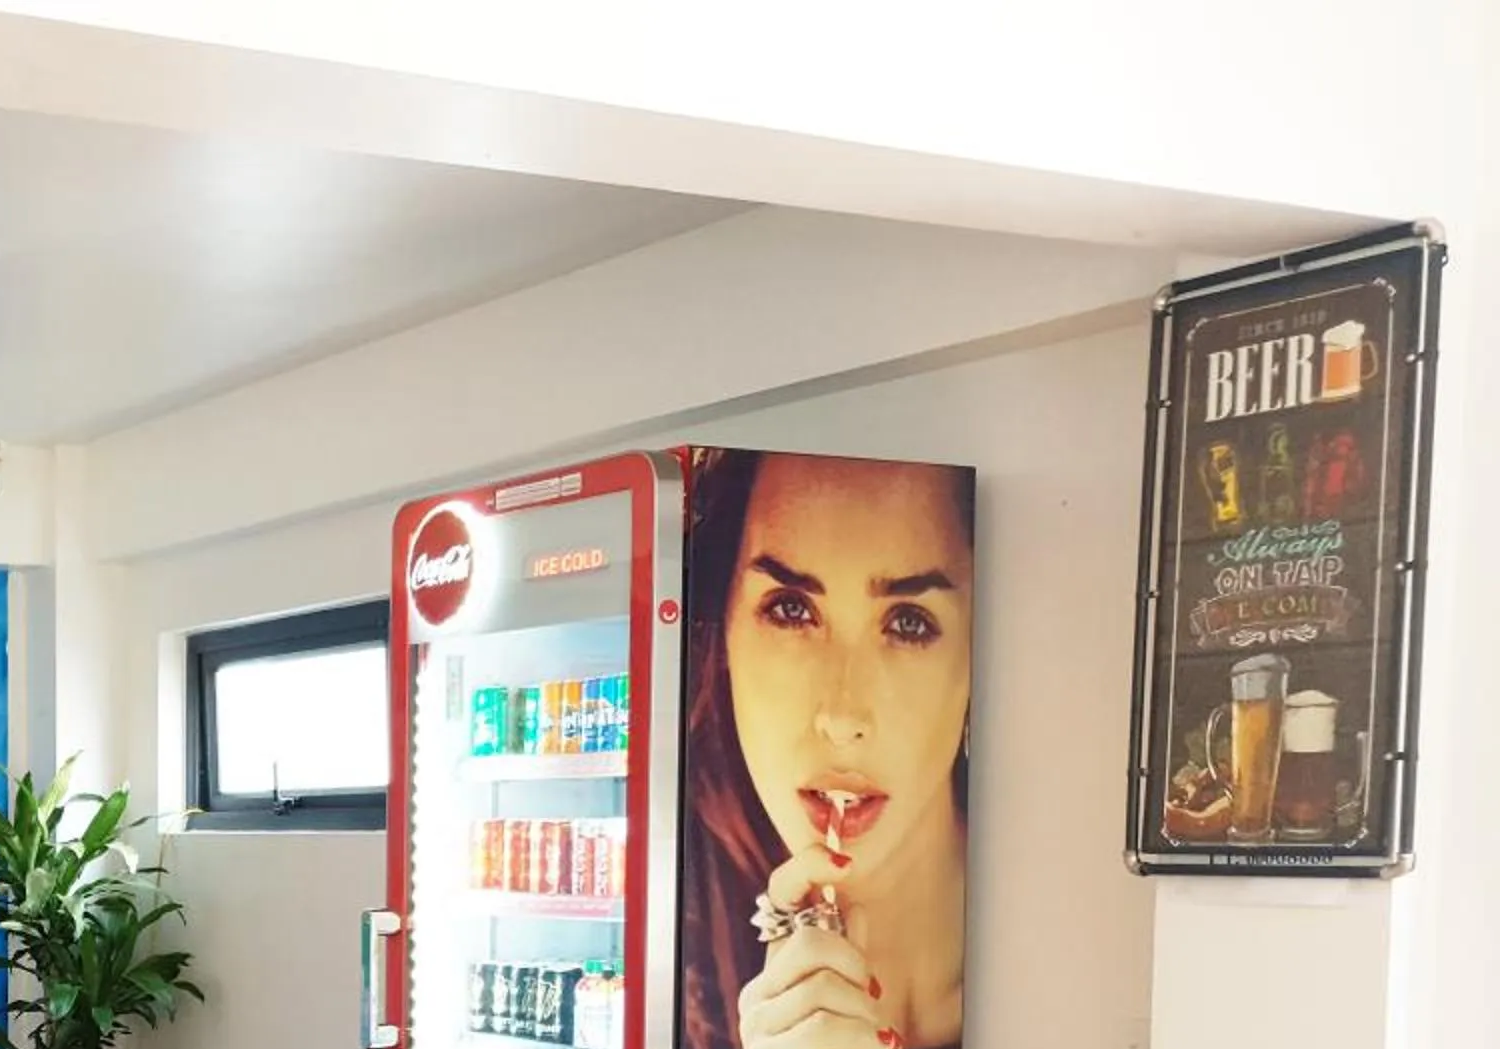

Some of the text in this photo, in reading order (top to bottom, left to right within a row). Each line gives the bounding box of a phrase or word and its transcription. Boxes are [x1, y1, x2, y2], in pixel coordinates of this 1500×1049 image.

[1204, 333, 1316, 422] BEER
[533, 549, 603, 577] ICE COLD
[1208, 524, 1344, 566] Always
[1214, 556, 1344, 594] ON TAP
